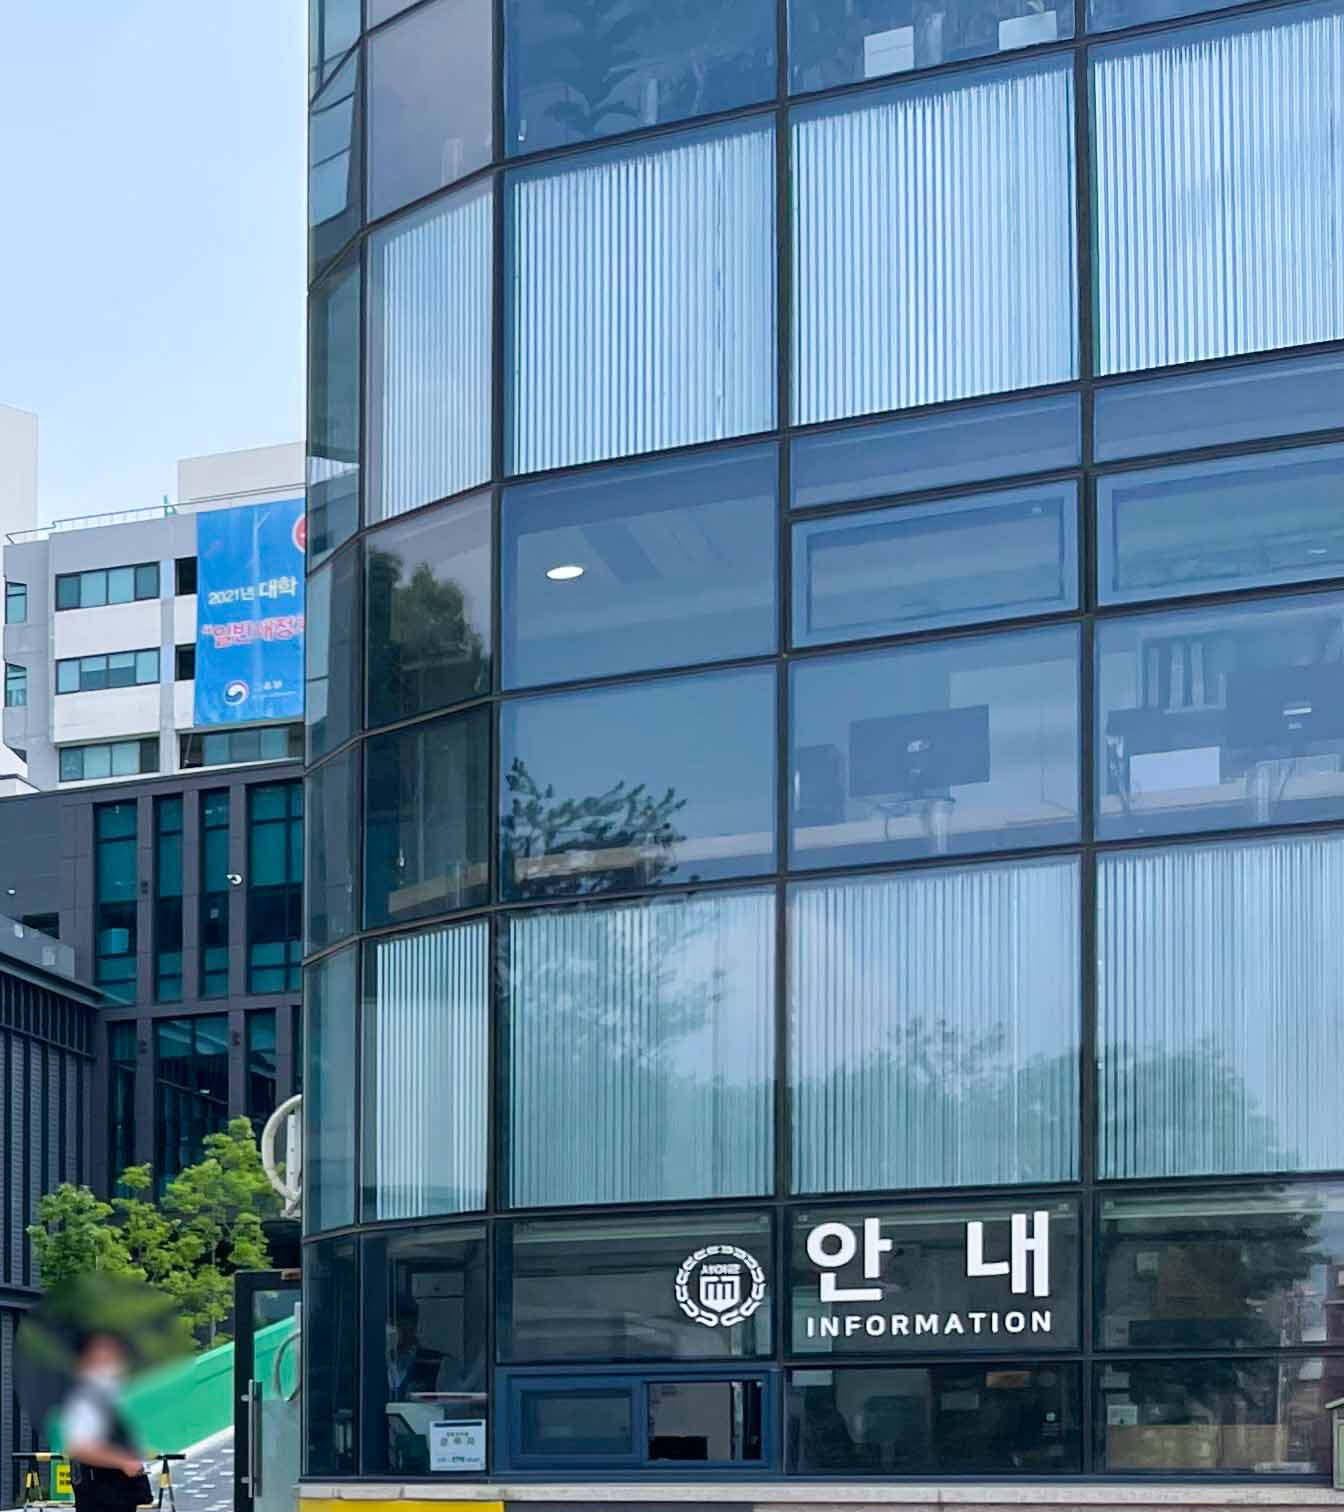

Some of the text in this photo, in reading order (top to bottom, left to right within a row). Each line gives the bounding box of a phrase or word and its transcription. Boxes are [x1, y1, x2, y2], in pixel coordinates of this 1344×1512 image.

[208, 576, 299, 605] 2021년 대학
[807, 1310, 1052, 1338] INFORMATION
